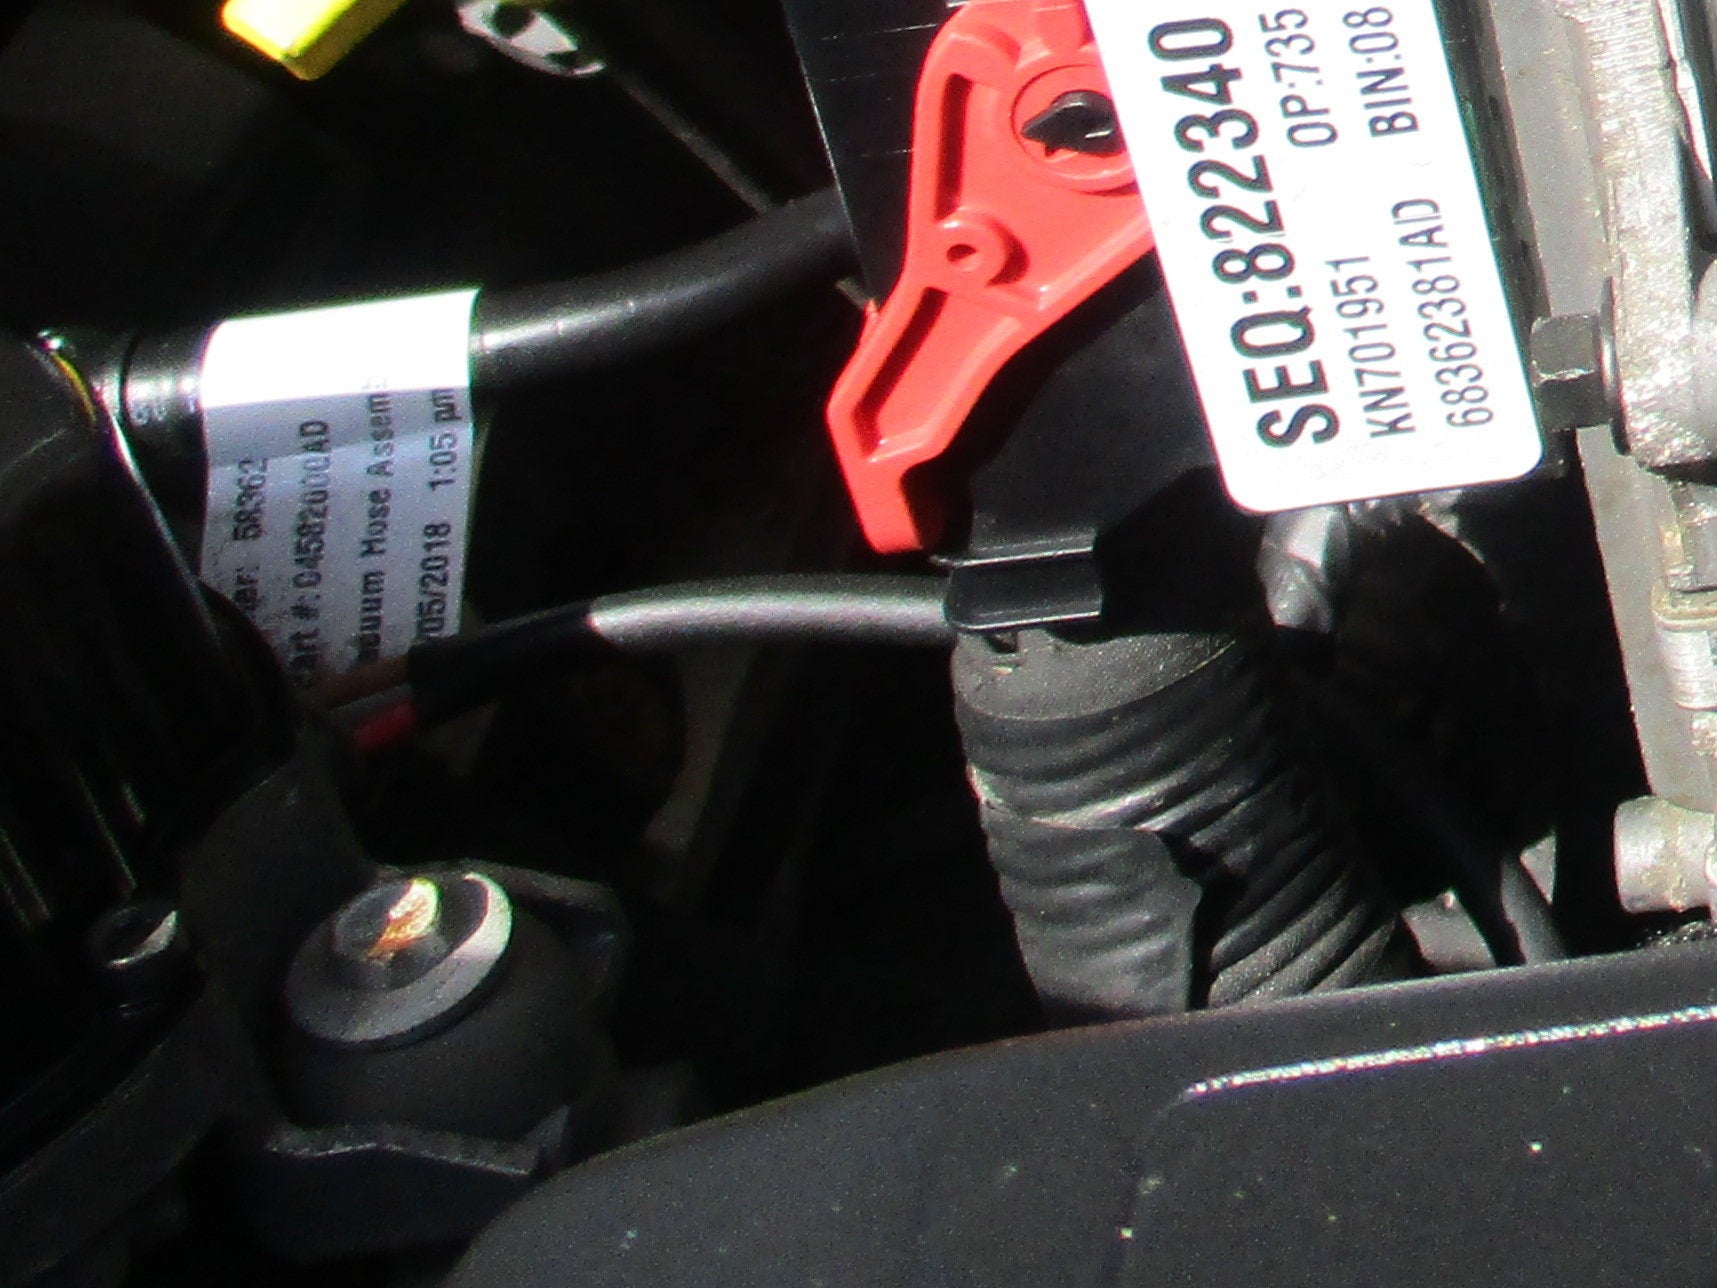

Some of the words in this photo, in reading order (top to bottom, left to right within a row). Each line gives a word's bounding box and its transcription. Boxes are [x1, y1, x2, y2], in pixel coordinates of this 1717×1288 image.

[1257, 7, 1339, 149] OP:735
[1341, 5, 1420, 139] BIN:08
[1146, 16, 1341, 449] SEQ:822340
[1390, 197, 1495, 429] 68362381AD
[1324, 255, 1417, 439] KN701951
